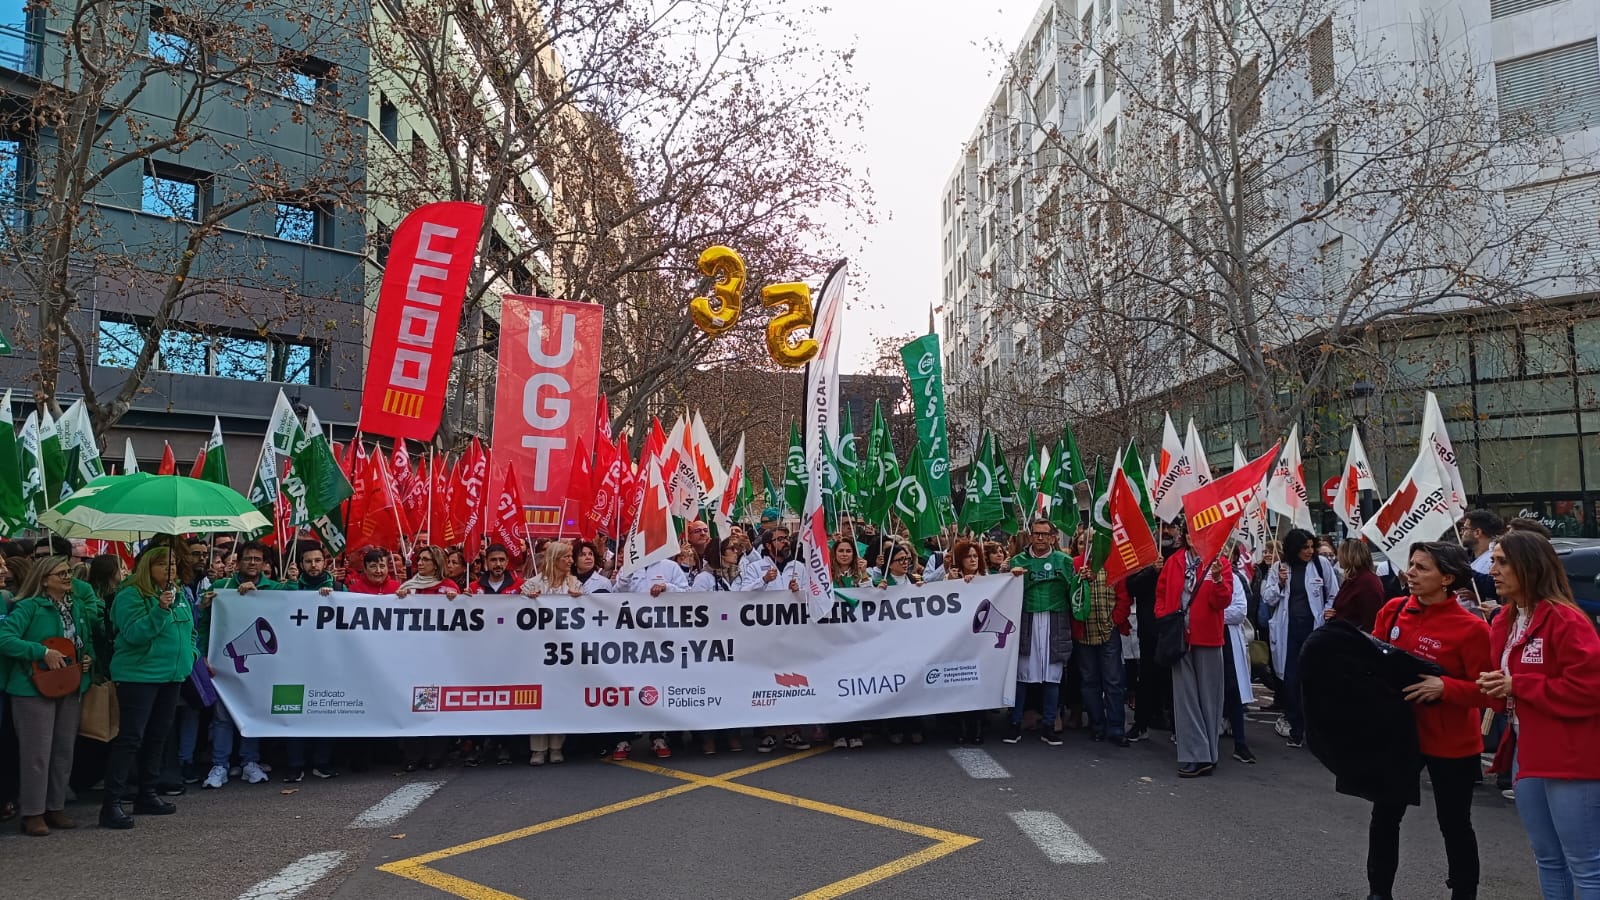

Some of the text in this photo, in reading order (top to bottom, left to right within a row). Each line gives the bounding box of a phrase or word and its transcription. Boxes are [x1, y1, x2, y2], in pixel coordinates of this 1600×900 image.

[389, 222, 458, 391] CCOO
[521, 309, 576, 491] UGT
[924, 375, 942, 458] CSIF
[1519, 508, 1539, 518] One
[190, 519, 230, 527] SATSE
[316, 605, 485, 631] PLANTILLAS
[516, 607, 585, 631] OPES
[615, 600, 709, 629] ÁGILES
[861, 592, 961, 622] PACTOS
[543, 639, 734, 669] 35 HORAS ¡YA!
[667, 685, 706, 696] Serveis
[838, 674, 905, 697] SIMAP
[308, 689, 345, 698] Sindicato
[445, 690, 510, 706] CCOO
[584, 686, 635, 708] UGT
[752, 688, 817, 699] INTERSINDICAL
[273, 704, 301, 712] SATSE
[307, 699, 363, 707] de Enfermería
[668, 696, 722, 708] Públics PV
[752, 698, 777, 707] SALUT
